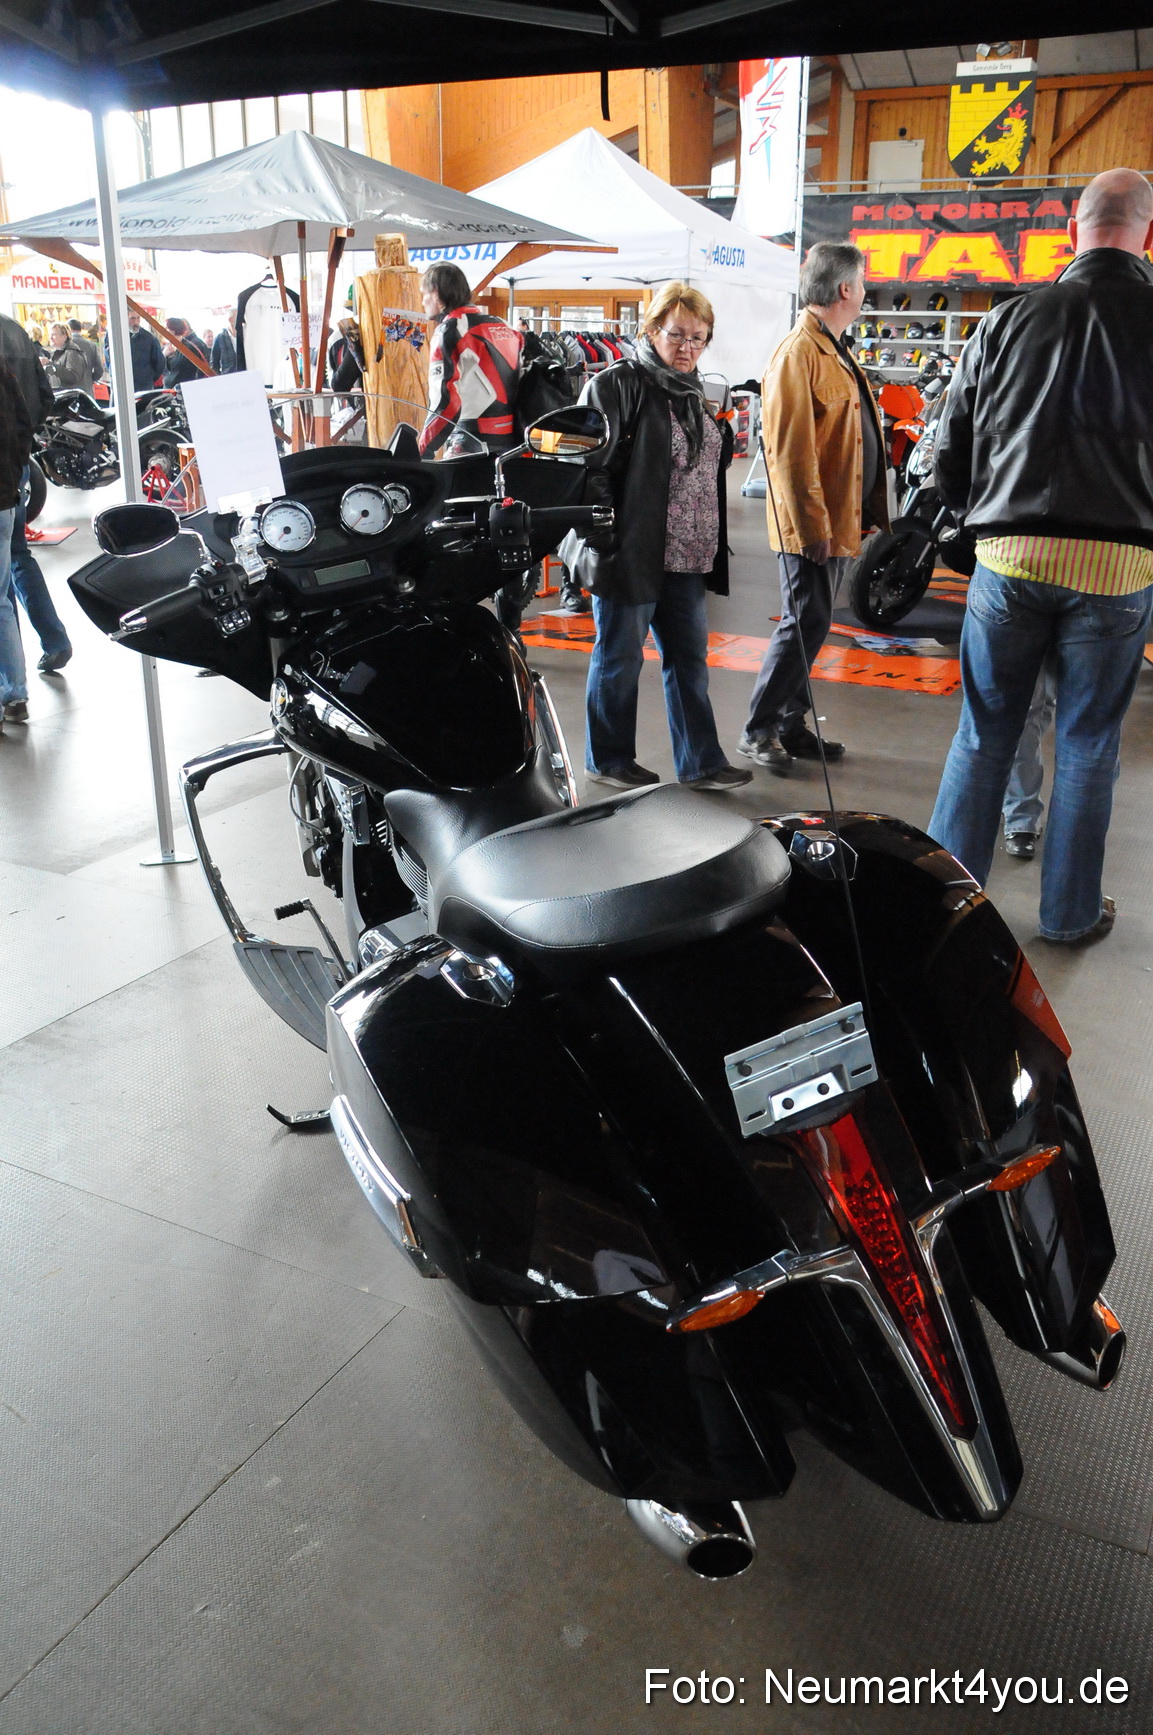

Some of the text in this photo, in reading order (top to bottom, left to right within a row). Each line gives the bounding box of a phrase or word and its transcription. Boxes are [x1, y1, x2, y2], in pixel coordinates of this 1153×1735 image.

[852, 199, 1080, 221] MOTORRA
[410, 242, 498, 263] AGUSTA
[712, 245, 745, 268] AGUSTA
[12, 275, 95, 290] MANDELN
